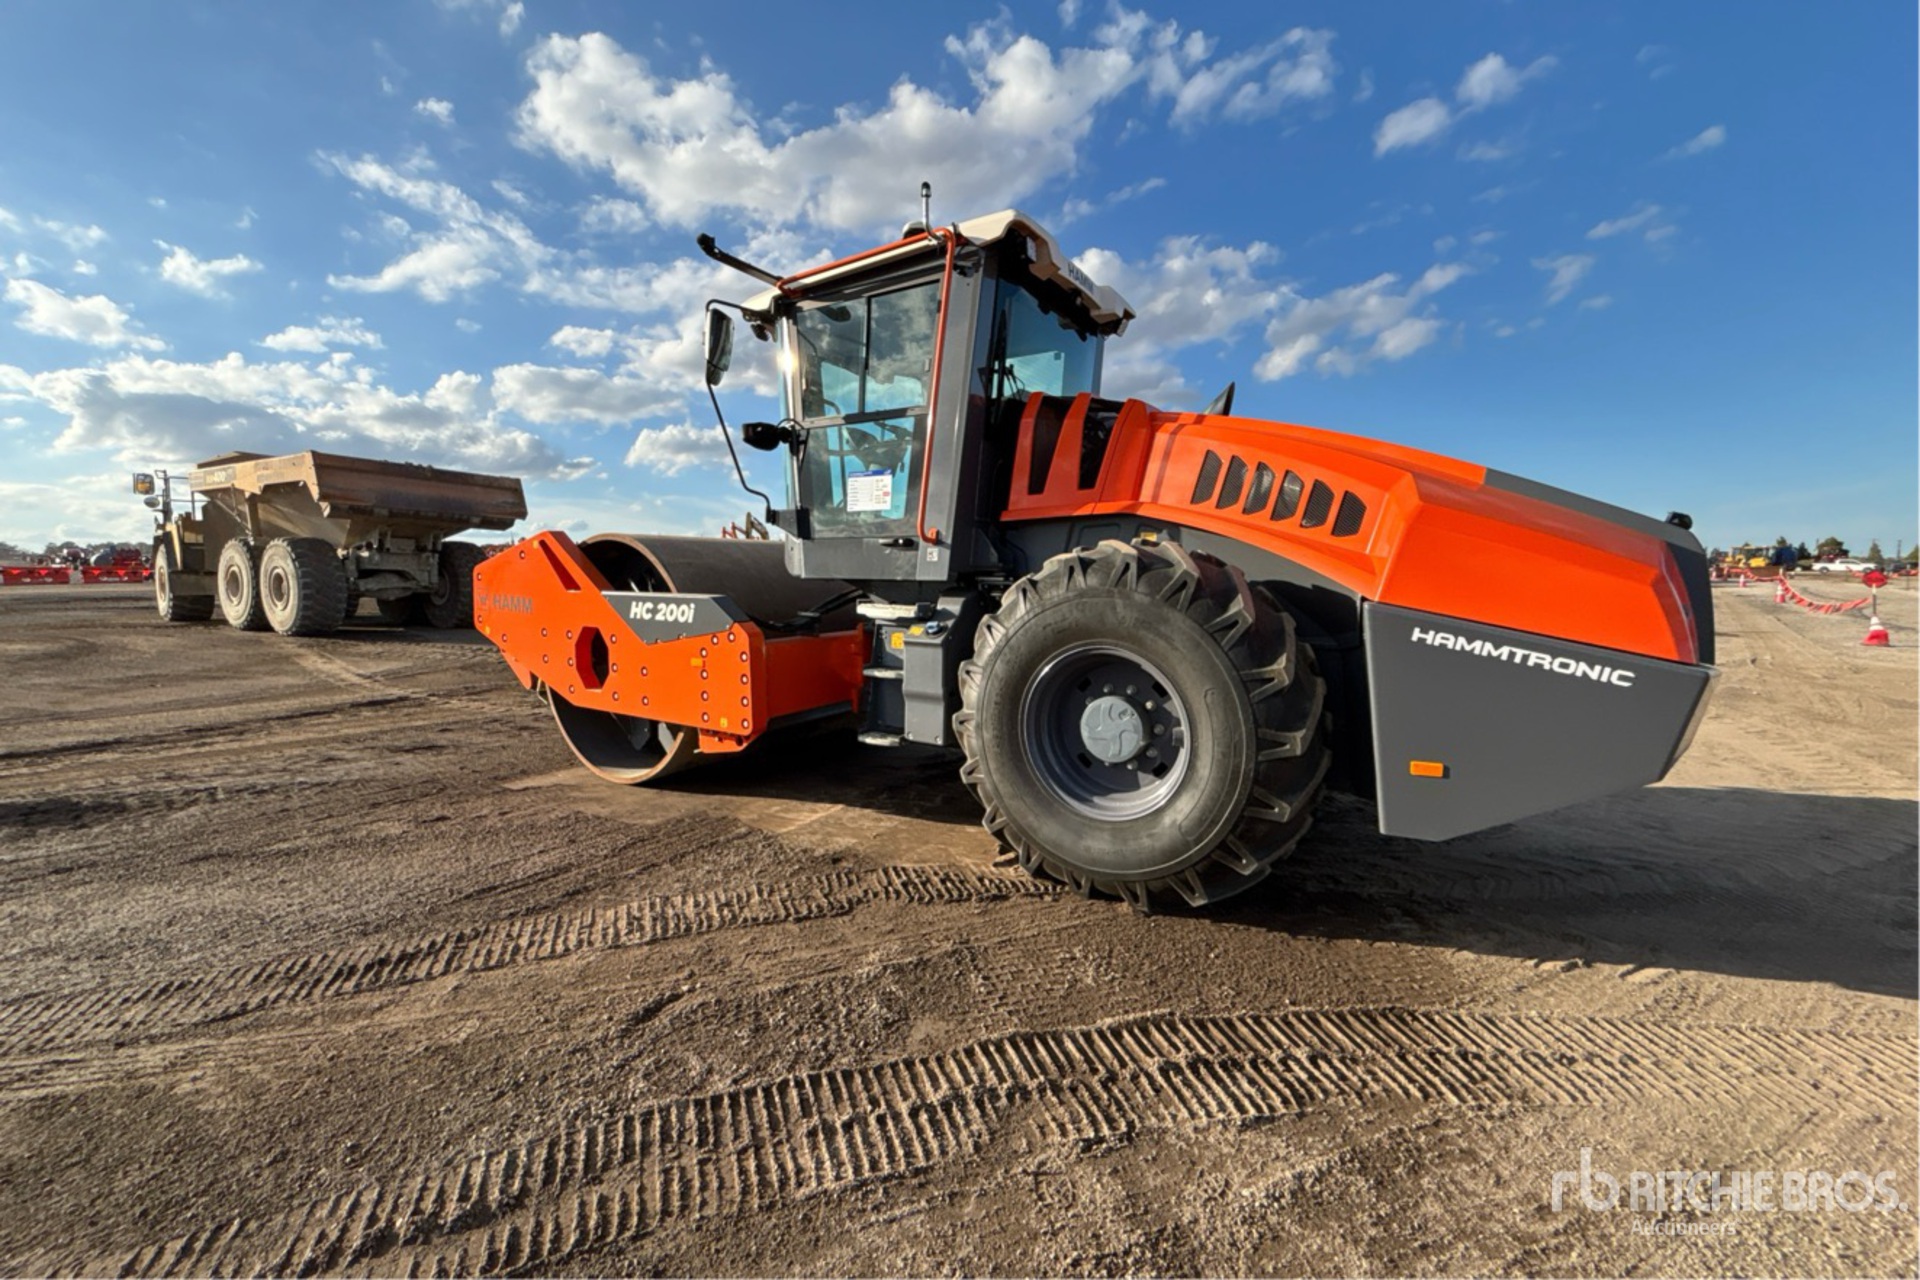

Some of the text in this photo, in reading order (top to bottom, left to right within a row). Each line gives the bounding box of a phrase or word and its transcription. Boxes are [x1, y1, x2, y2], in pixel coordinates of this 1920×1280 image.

[493, 594, 534, 615] HAMM
[629, 601, 696, 623] HC 200i
[1411, 627, 1636, 687] HAMMTRONIC
